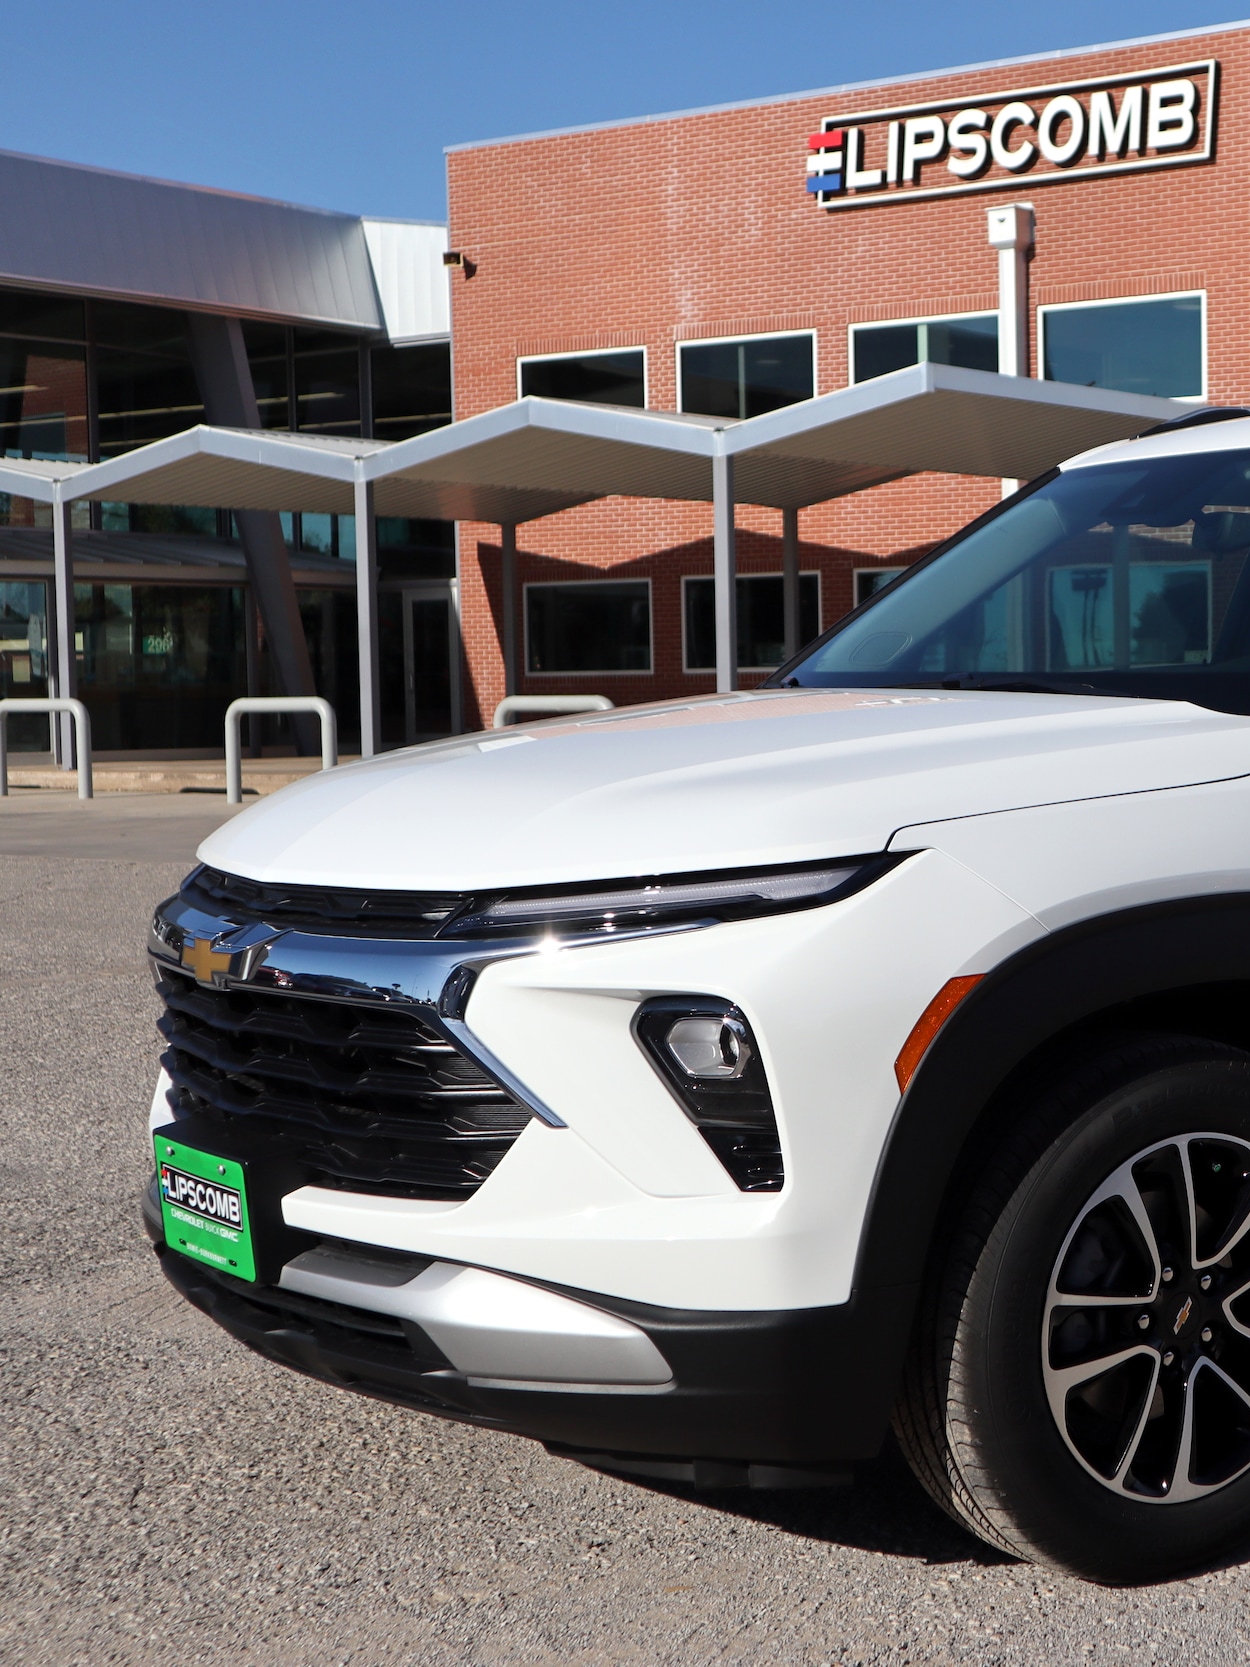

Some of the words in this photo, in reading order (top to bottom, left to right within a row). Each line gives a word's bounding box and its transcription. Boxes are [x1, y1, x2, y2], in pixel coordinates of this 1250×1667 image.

[845, 78, 1197, 189] LIPSCOMB
[166, 1171, 241, 1223] LIPSCOMB
[171, 1208, 204, 1229] CHEVROLET
[219, 1228, 239, 1242] GMC
